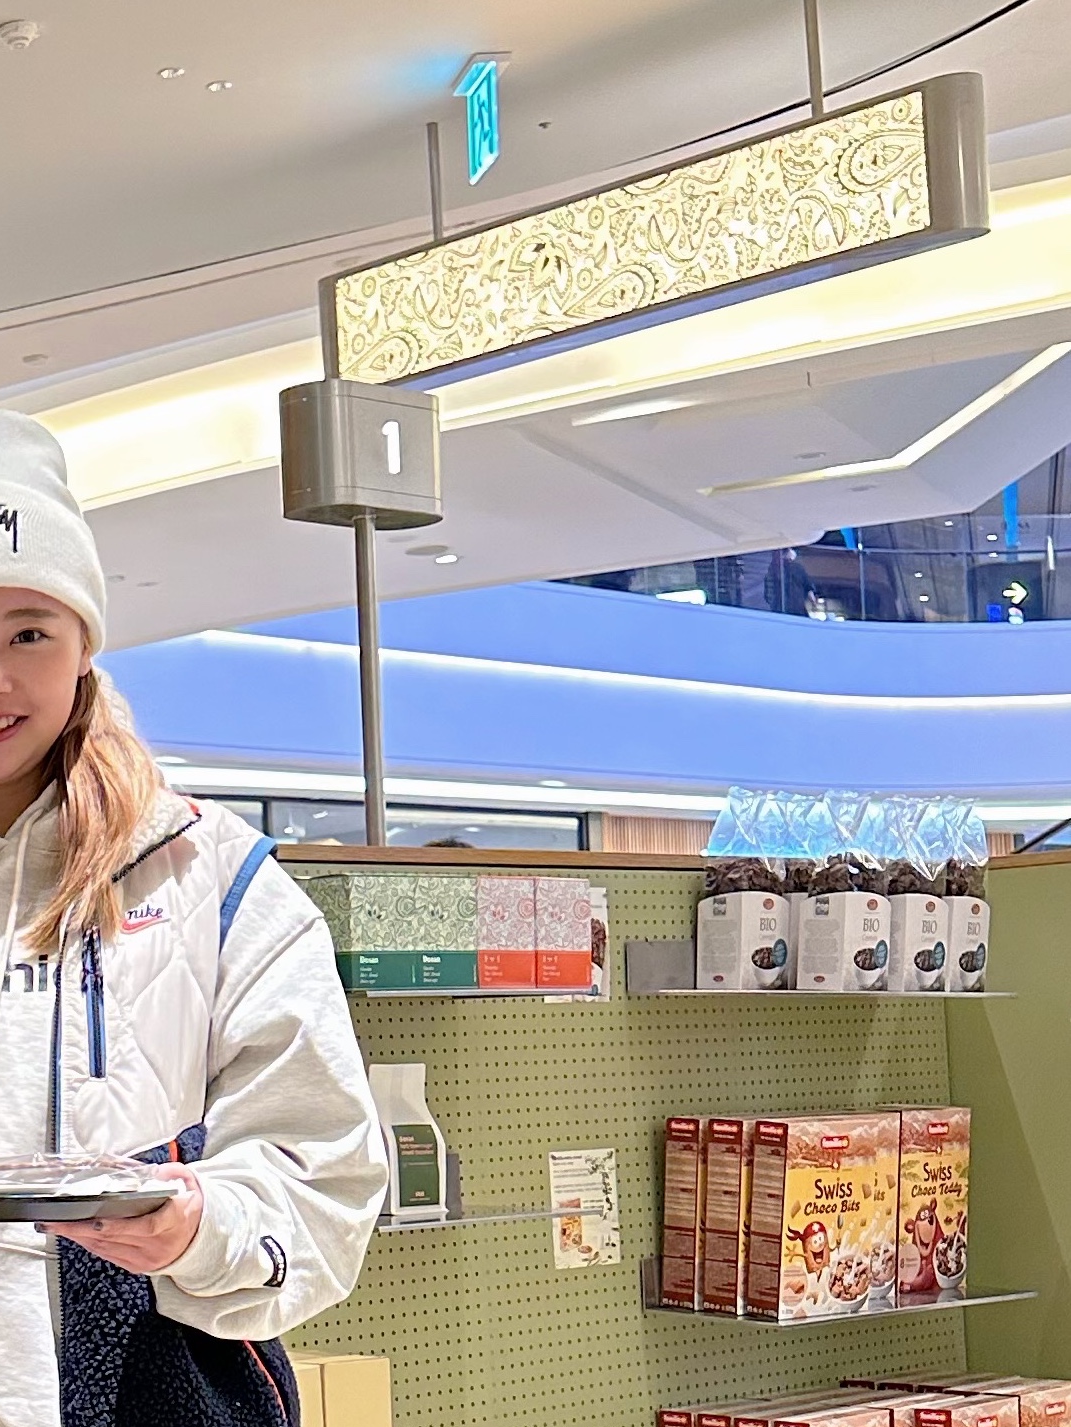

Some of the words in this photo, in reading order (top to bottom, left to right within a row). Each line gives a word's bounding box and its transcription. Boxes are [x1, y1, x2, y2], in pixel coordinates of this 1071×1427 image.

[381, 420, 401, 475] 1
[127, 903, 165, 921] nike
[759, 917, 778, 932] BIO
[862, 918, 880, 933] BIO
[921, 919, 938, 935] BIO
[923, 1160, 952, 1182] Swiss
[814, 1177, 853, 1200] Swiss
[911, 1184, 936, 1199] Choco
[939, 1180, 963, 1197] Teddy
[803, 1201, 837, 1216] Choco
[840, 1198, 861, 1213] Bits
